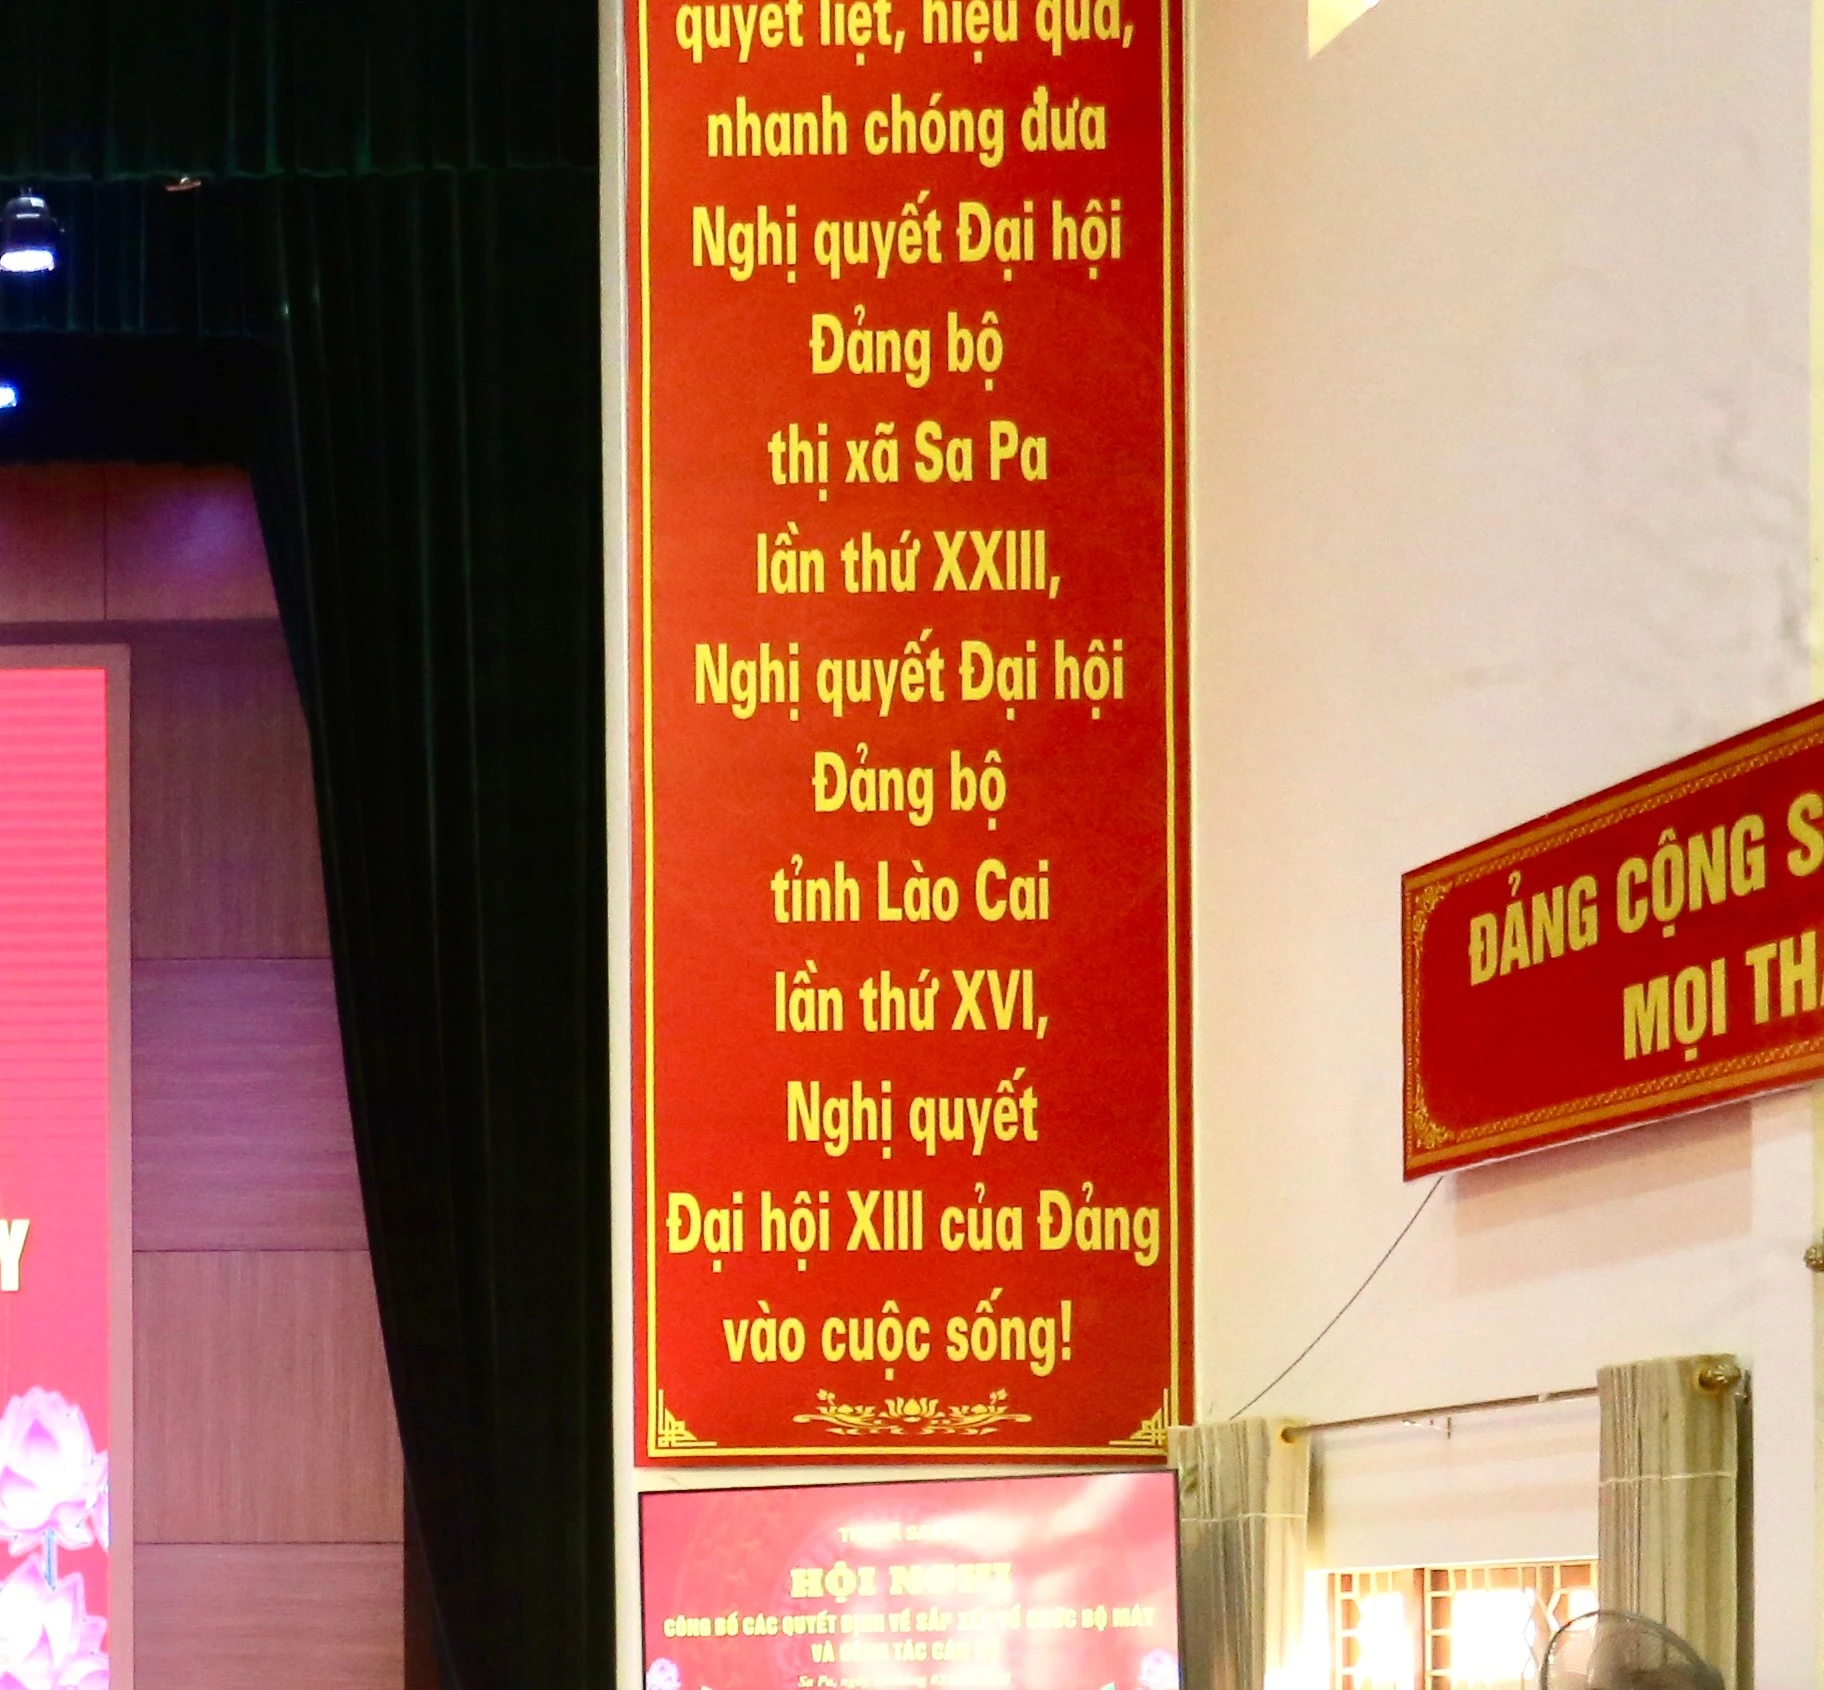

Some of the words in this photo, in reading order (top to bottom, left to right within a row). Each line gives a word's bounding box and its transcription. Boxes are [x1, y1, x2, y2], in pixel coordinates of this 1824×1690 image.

[707, 94, 848, 158] nhanh
[864, 92, 1005, 168] chóng
[1021, 85, 1106, 152] đưa
[692, 204, 797, 284] Nghị
[813, 189, 943, 280] quyết
[956, 200, 1034, 282] Đại
[1052, 198, 1121, 280] hội
[808, 303, 931, 389] Đảng
[947, 310, 1004, 391] bộ
[767, 422, 829, 502] thị
[845, 421, 899, 484] xã
[914, 420, 973, 483] Sa
[989, 420, 1047, 481] Pa
[757, 521, 825, 595] lần
[840, 529, 921, 594] thứ
[933, 529, 1061, 599] XXIII,
[695, 642, 800, 722] Nghị
[816, 628, 945, 718] quyết
[958, 639, 1037, 721] Đại
[1054, 639, 1124, 720] hội
[811, 742, 934, 827] Đảng
[950, 749, 1007, 831] bộ
[770, 853, 860, 923] tỉnh
[877, 859, 959, 922] Lào
[975, 858, 1049, 922] Cai
[1468, 871, 1600, 986] ĐẢNG
[1615, 813, 1768, 940] CỘNG
[775, 959, 844, 1033] lần
[858, 968, 940, 1032] thứ
[951, 969, 1048, 1039] XVI,
[1623, 957, 1728, 1063] MỌI
[787, 1080, 892, 1160] Nghị
[909, 1067, 1038, 1156] quyết
[665, 1191, 744, 1273] Đại
[761, 1190, 830, 1272] hội
[846, 1189, 923, 1251] XIII
[940, 1182, 1023, 1252] của
[1036, 1181, 1160, 1267] Đảng
[722, 1300, 806, 1363] vào
[821, 1300, 930, 1381] cuộc
[946, 1287, 1072, 1377] sống!
